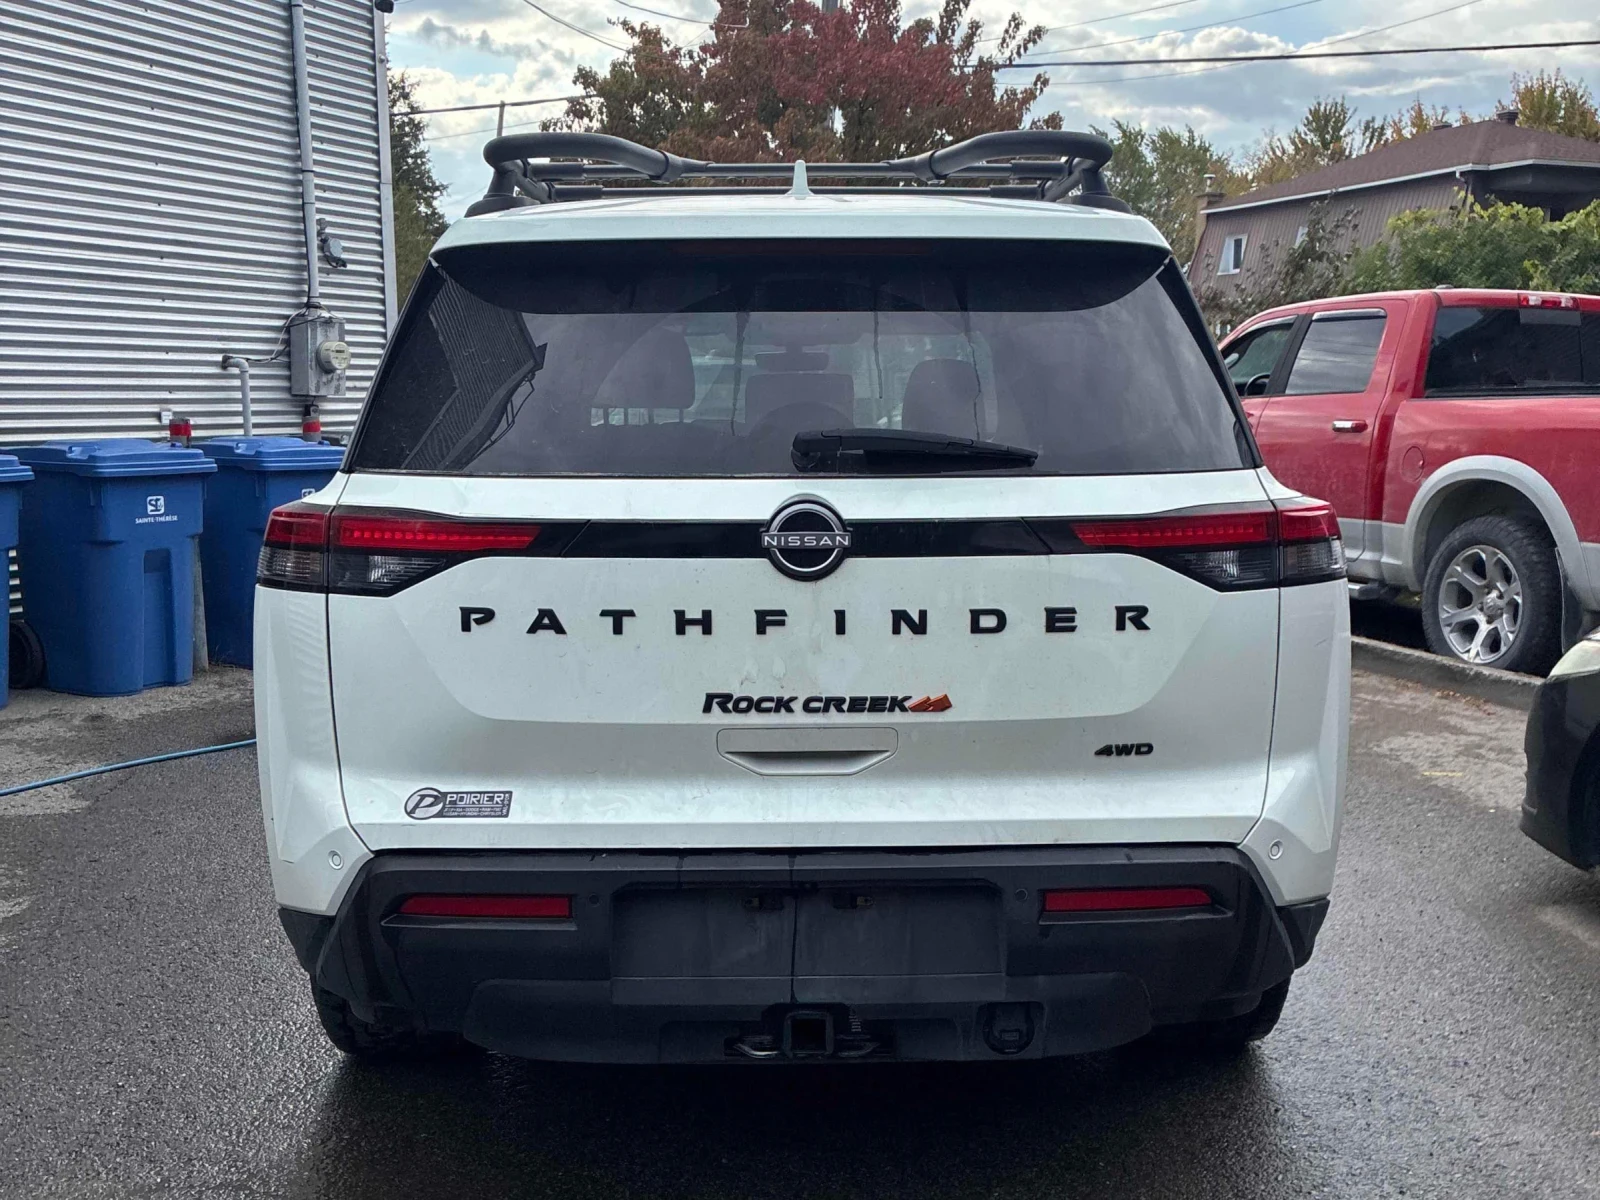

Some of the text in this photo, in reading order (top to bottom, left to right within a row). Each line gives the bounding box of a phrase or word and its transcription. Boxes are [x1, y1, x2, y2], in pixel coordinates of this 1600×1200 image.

[764, 535, 849, 546] NISSAN
[460, 604, 1152, 636] PATHFINDER
[702, 692, 913, 714] ROCK CREEK
[1094, 742, 1154, 756] 4WD
[446, 793, 503, 804] POIRIER
